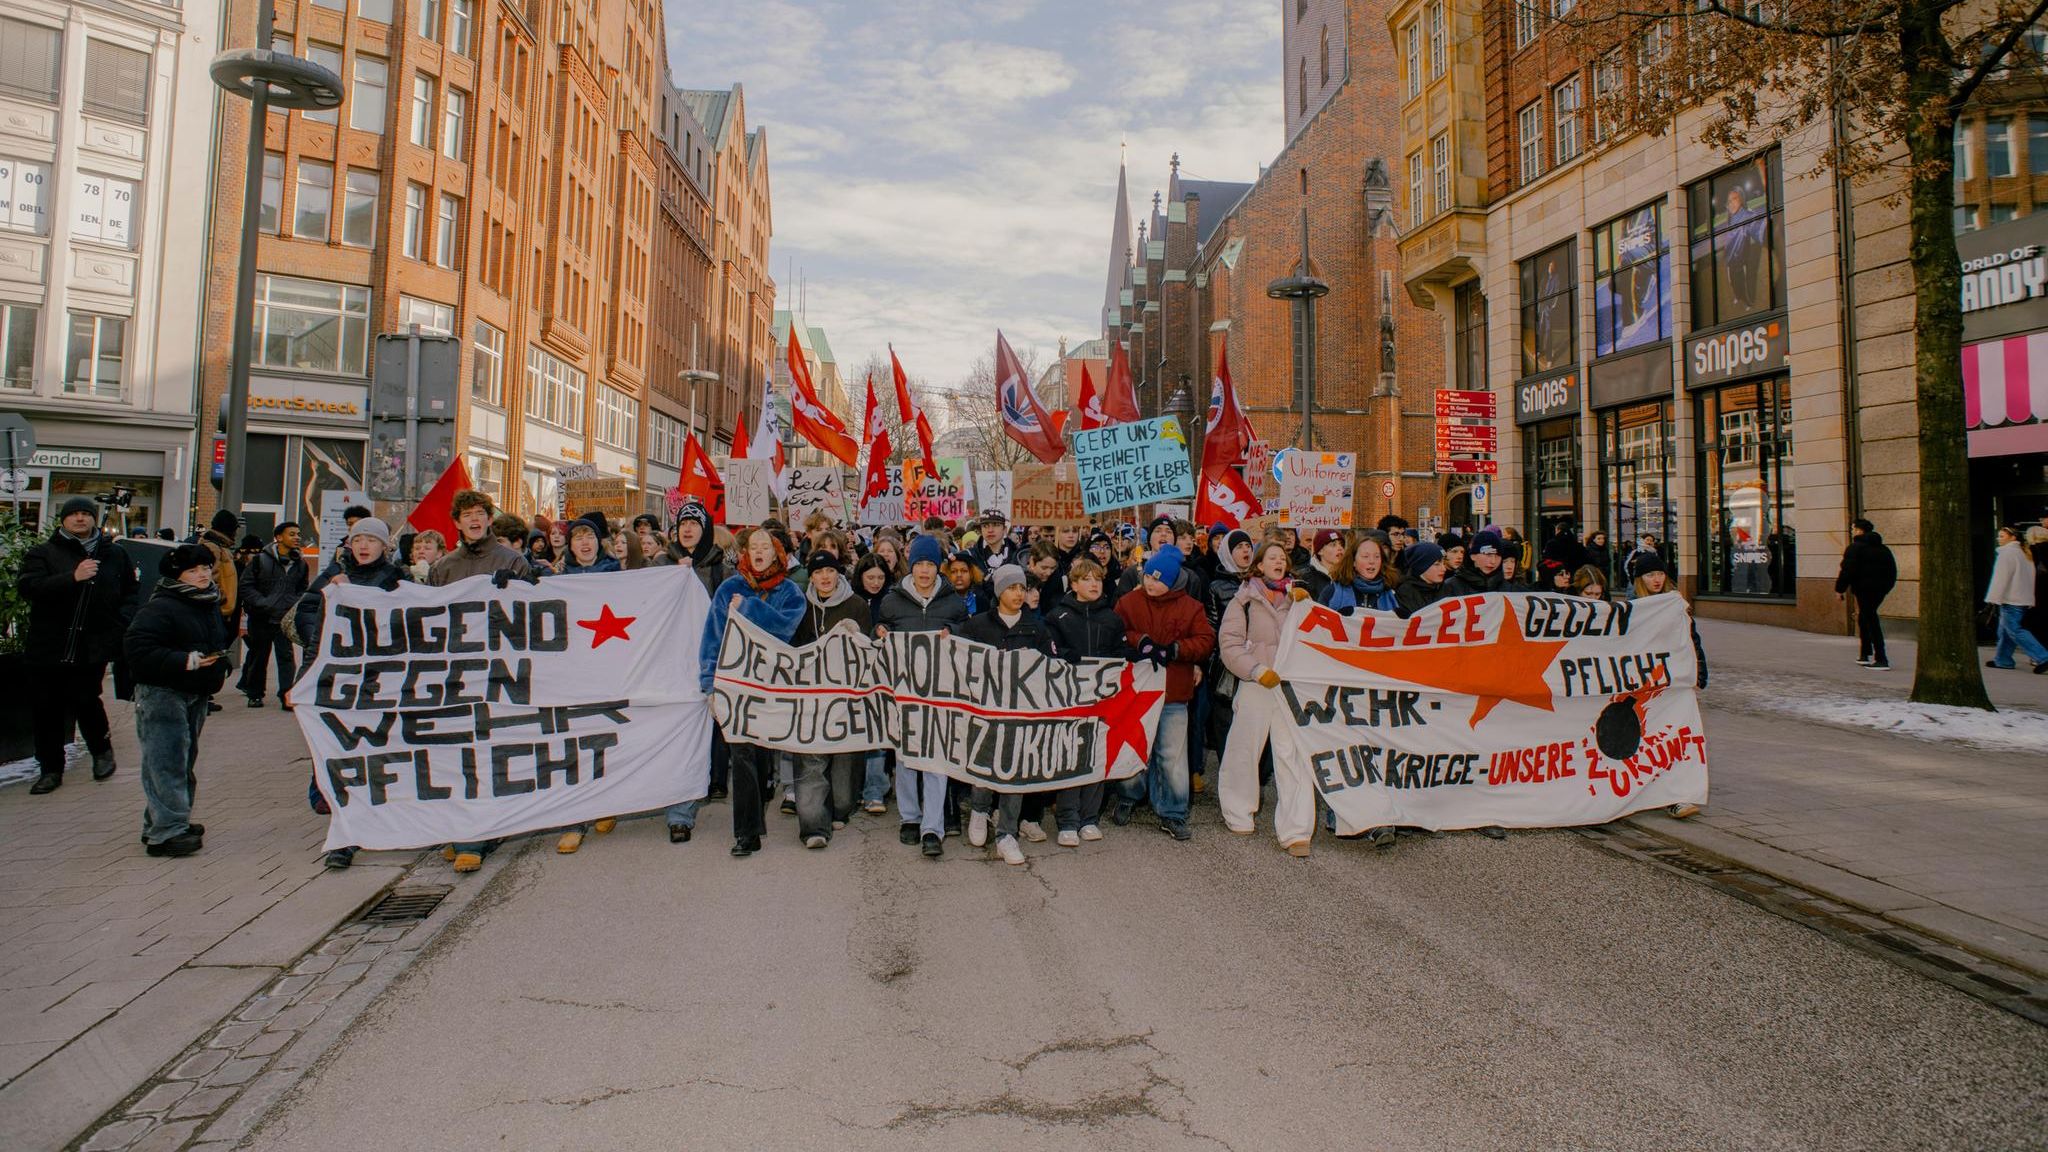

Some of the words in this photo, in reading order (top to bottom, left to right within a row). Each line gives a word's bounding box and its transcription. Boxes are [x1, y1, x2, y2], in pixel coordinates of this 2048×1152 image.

[25, 173, 43, 184] 00
[84, 183, 100, 195] 78
[115, 190, 130, 201] 70
[20, 203, 44, 214] OBIL
[109, 220, 122, 228] DE
[1961, 253, 2006, 273] ORLD
[2010, 245, 2039, 260] OF
[1961, 257, 2045, 312] ANDY
[1695, 326, 1768, 375] snipes
[1522, 376, 1568, 414] snipes
[1075, 428, 1118, 453] GEBT
[1127, 421, 1158, 442] UNS
[1078, 445, 1150, 474] FREIHEIT
[1083, 470, 1128, 490] ZIEHT
[1131, 460, 1189, 483] SELBER
[911, 485, 958, 499] WEHR
[1088, 493, 1101, 508] IN
[1106, 485, 1134, 504] DEN
[1139, 477, 1180, 499] KRIEG
[868, 502, 905, 520] FRON
[331, 600, 568, 657] JUGEND
[1298, 595, 1486, 648] ALLEE
[1524, 595, 1633, 638] GEGEN
[315, 658, 532, 710] GEGEN
[1560, 652, 1671, 697] PFLICHT
[320, 699, 631, 751] WEHR
[967, 716, 1102, 782] ZUKUNFT
[326, 732, 618, 808] PFLICHT
